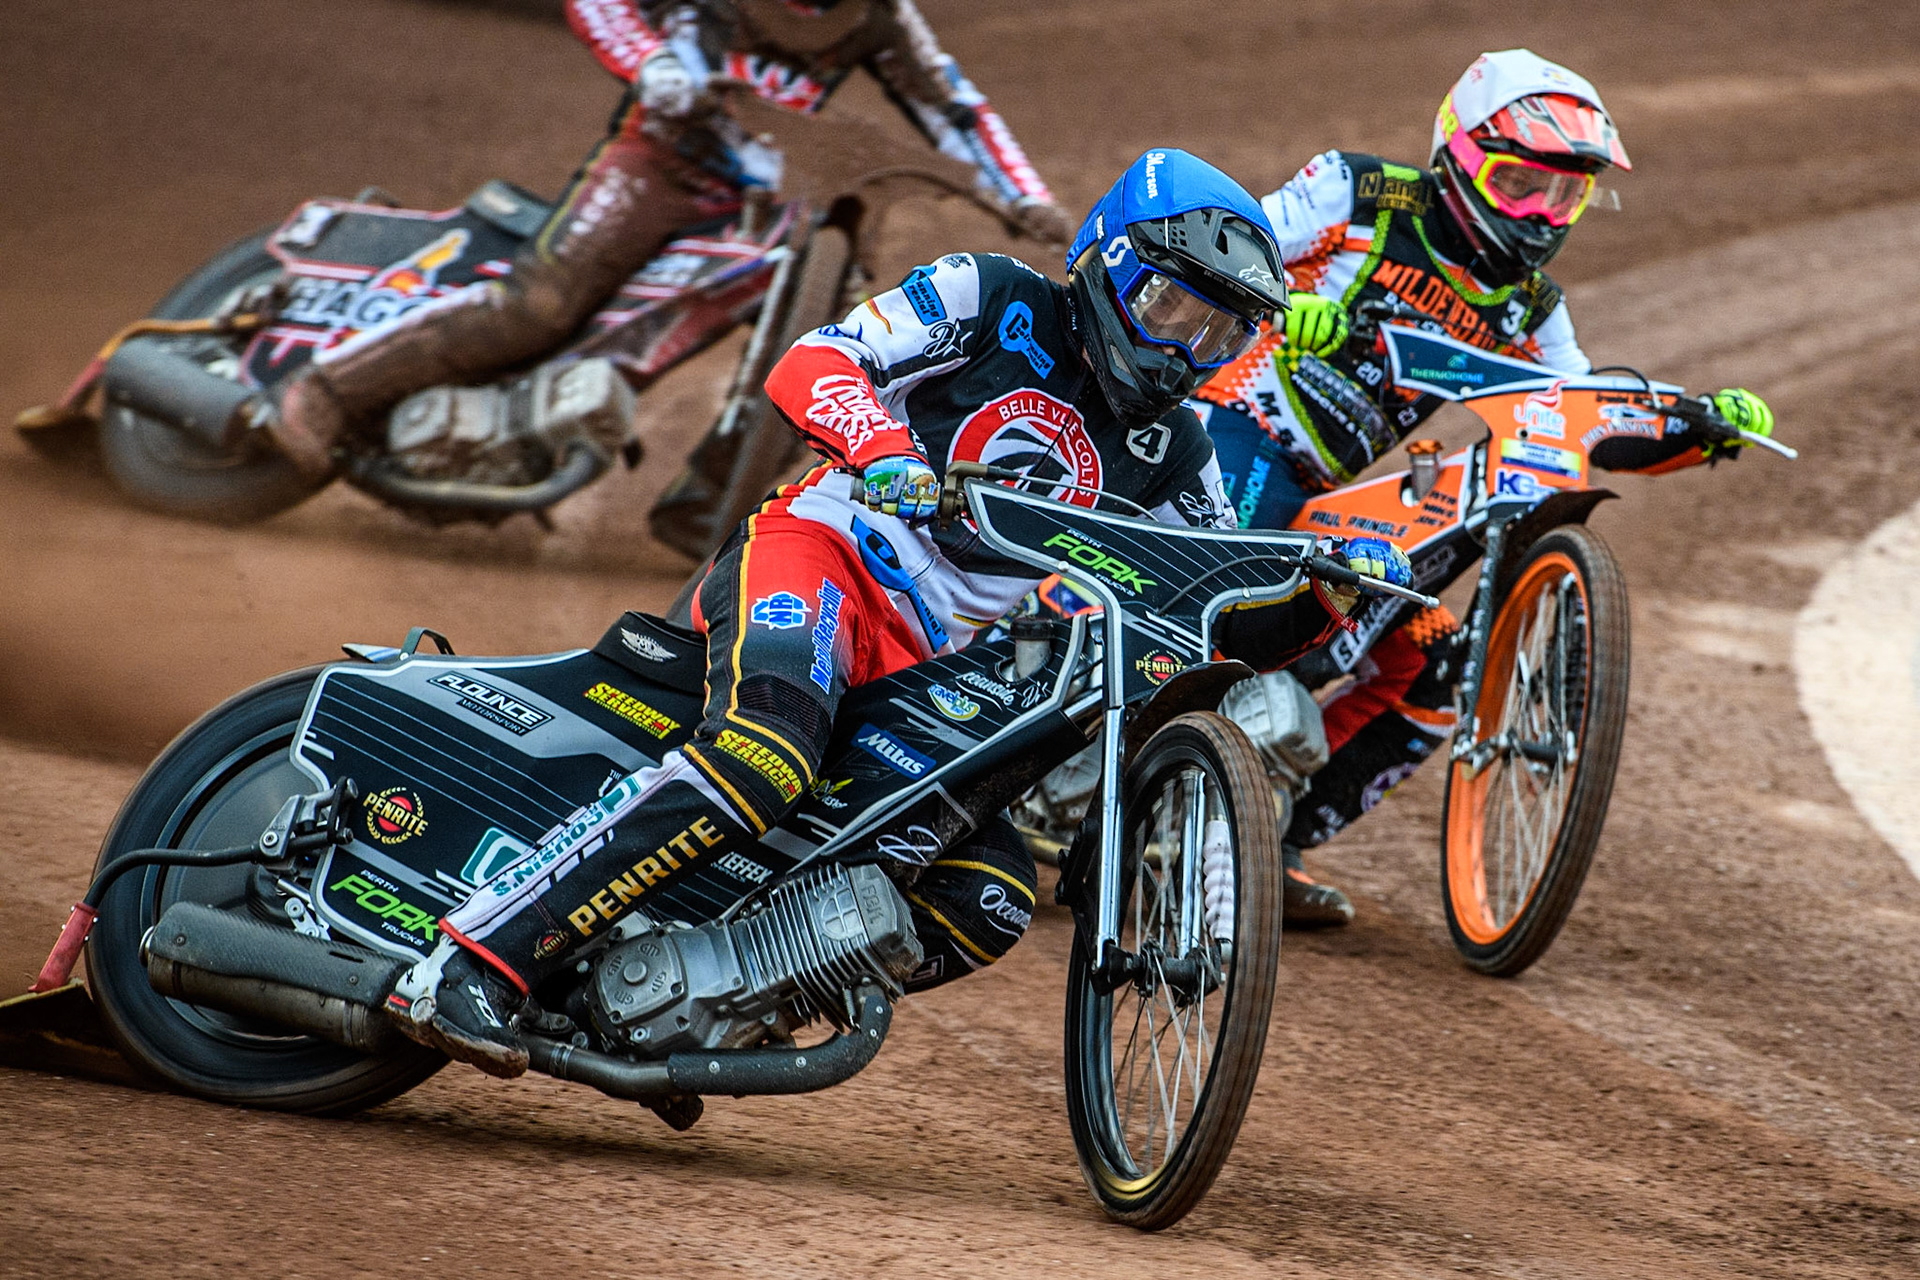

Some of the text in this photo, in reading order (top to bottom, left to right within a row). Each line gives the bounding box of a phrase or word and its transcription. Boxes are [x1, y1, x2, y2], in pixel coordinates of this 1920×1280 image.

[1410, 367, 1485, 384] THERMOHOME
[998, 398, 1046, 421] BELLE
[1075, 439, 1094, 498] COLTS
[1132, 426, 1164, 459] 4
[1308, 511, 1341, 527] PAUL
[1067, 529, 1102, 548] PERTH
[1043, 533, 1158, 595] FORK
[1095, 573, 1136, 597] TRUCKS
[460, 699, 527, 735] MOTORSPORT
[588, 681, 682, 731] SPEEDWAY
[857, 733, 925, 774] Mitas
[363, 792, 429, 836] PENRITE
[492, 811, 603, 896] COUSIN'S
[361, 870, 399, 893] PERTH
[567, 815, 725, 936] PENRITE
[330, 874, 439, 942] FORK
[381, 922, 425, 947] TRUCKS
[533, 931, 569, 960] PENRITE
